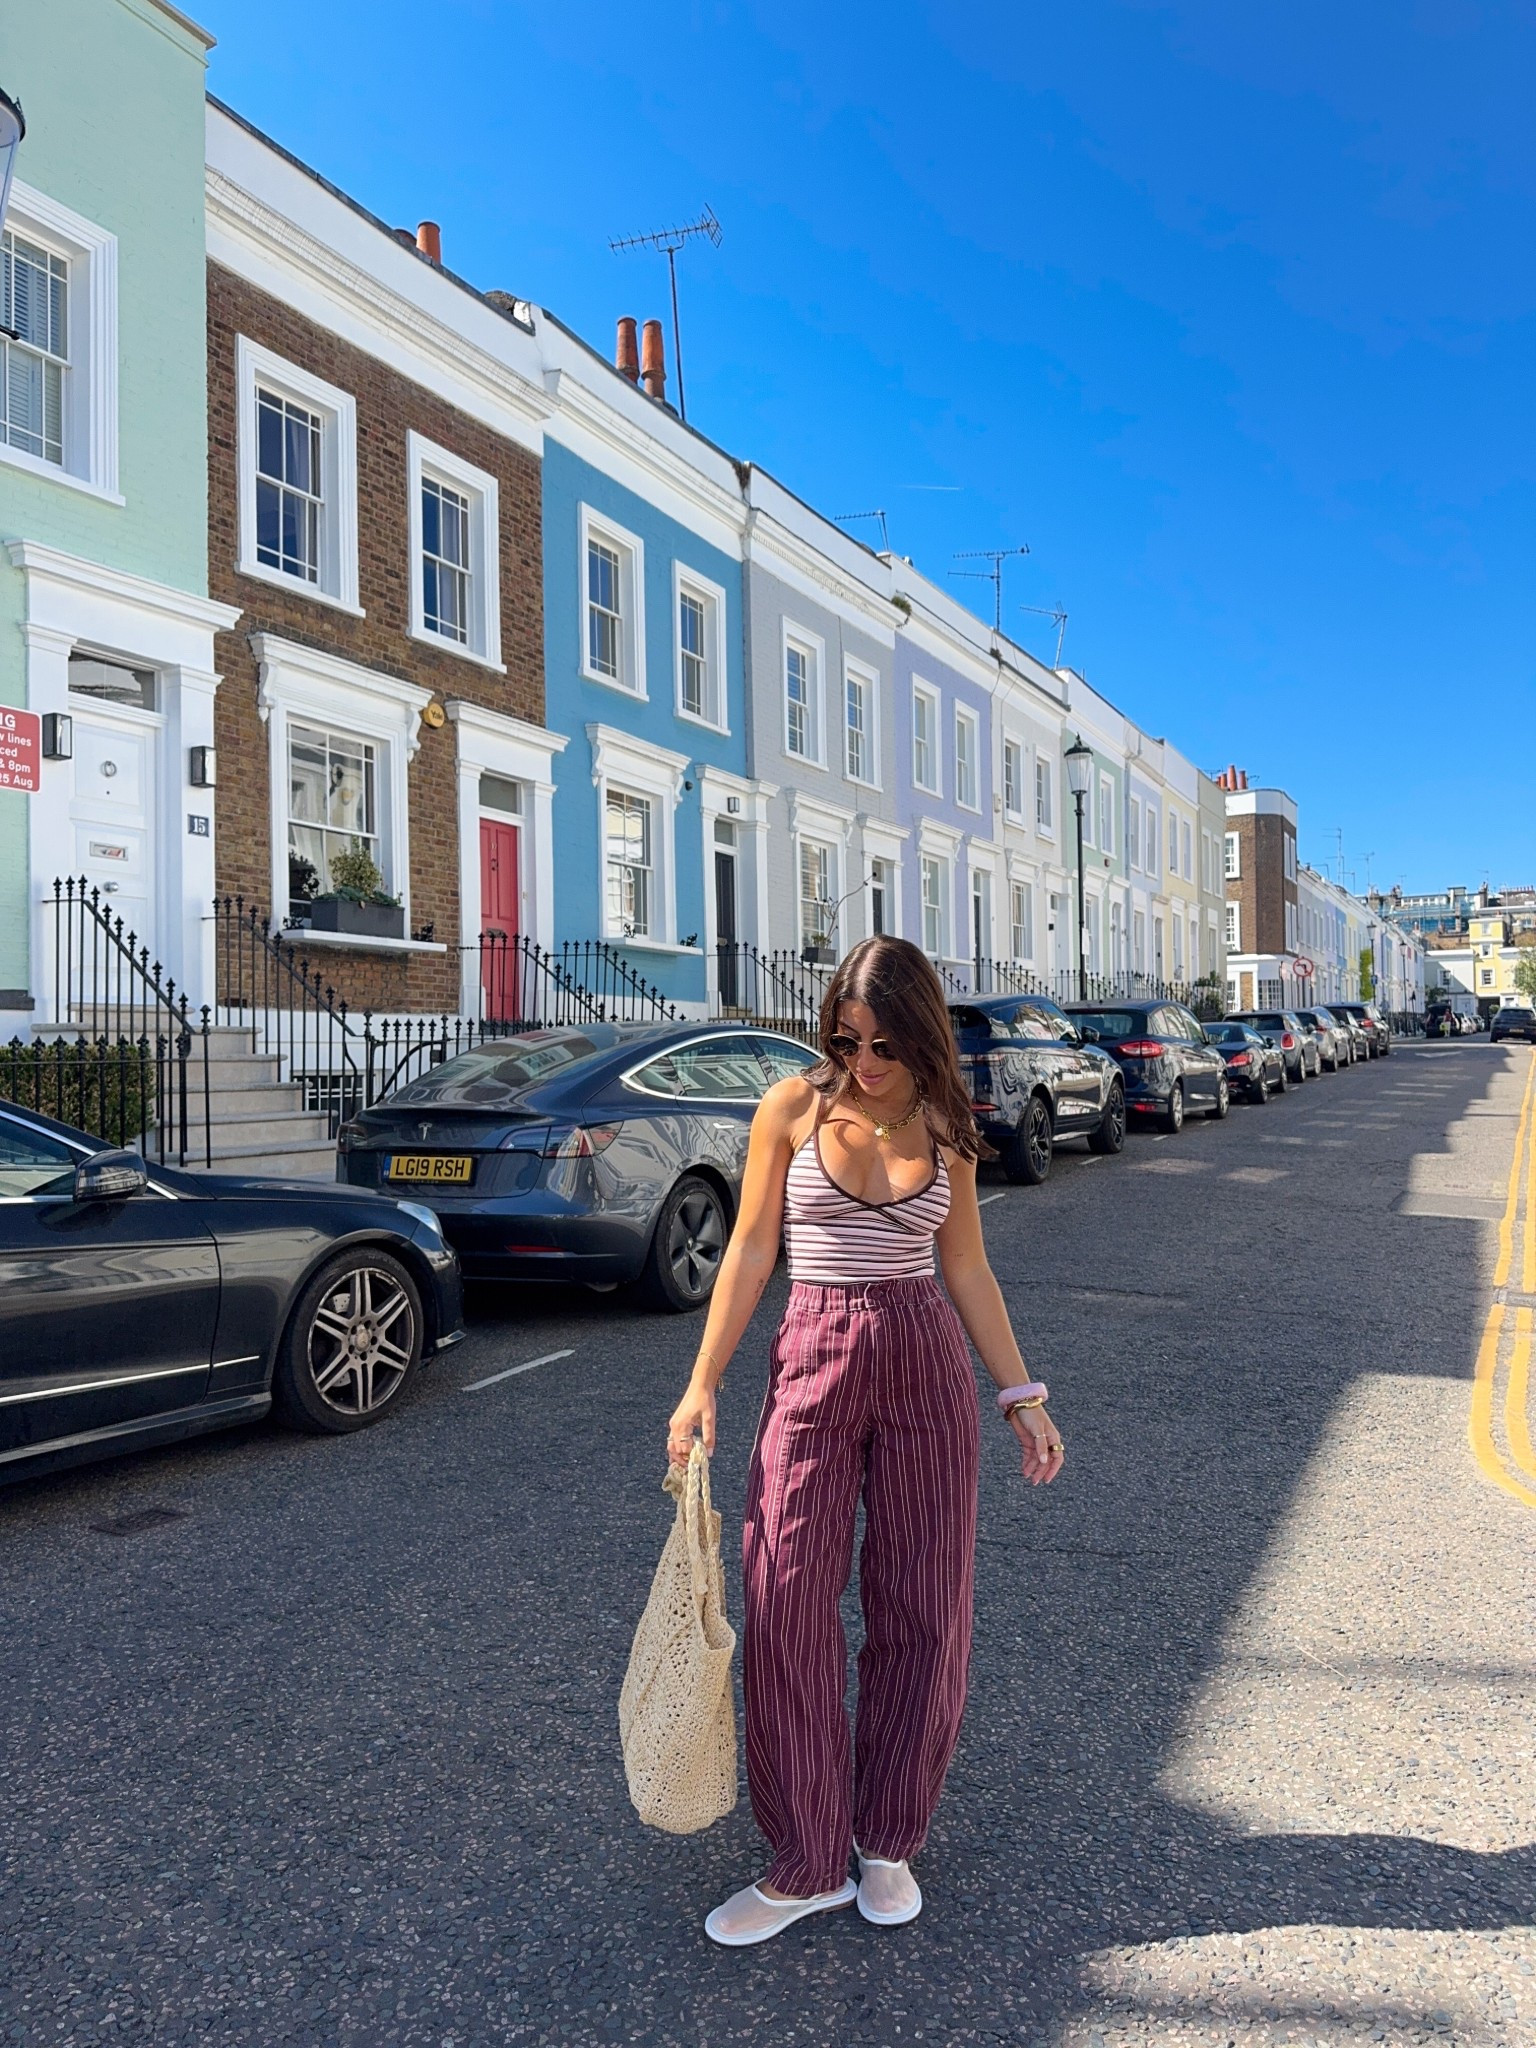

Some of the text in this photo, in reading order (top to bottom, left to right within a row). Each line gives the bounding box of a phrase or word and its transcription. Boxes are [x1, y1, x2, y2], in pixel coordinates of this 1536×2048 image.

[7, 732, 32, 747] lines
[8, 760, 31, 773] 8pm
[13, 774, 33, 789] Aug
[193, 817, 206, 834] 15
[395, 1158, 430, 1177] LG19
[433, 1159, 466, 1178] RSH
